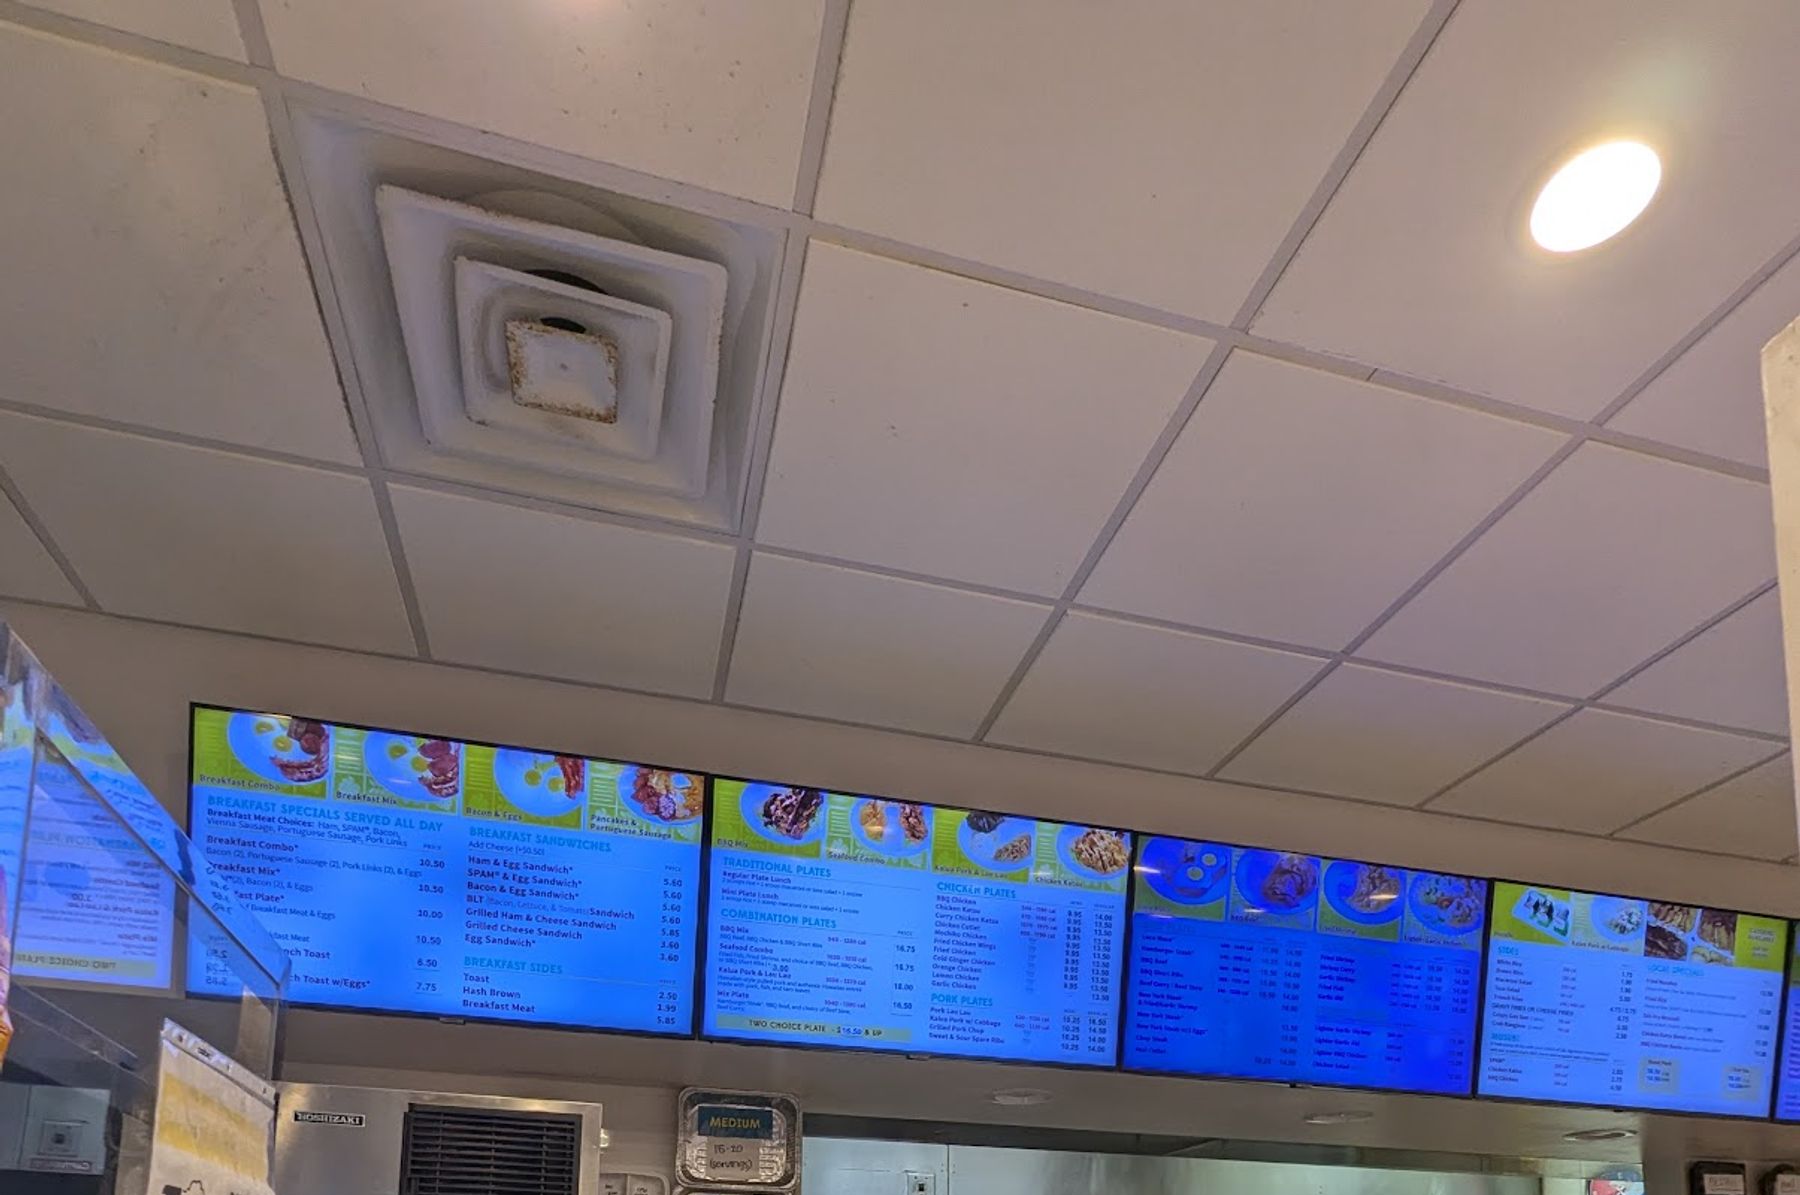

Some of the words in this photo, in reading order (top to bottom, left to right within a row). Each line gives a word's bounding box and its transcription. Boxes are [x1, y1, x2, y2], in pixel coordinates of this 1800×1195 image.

[200, 774, 245, 787] Breakfast
[248, 781, 280, 791] Combo
[336, 791, 380, 802] Breakfast
[382, 797, 397, 805] Mix
[207, 796, 276, 813] BREAKFAST
[281, 804, 340, 820] SPECIALS
[344, 811, 390, 826] SERVED
[394, 818, 415, 830] ALL
[420, 822, 443, 832] DAY
[466, 807, 492, 816] Bacon
[502, 811, 522, 821] Eggs
[590, 814, 629, 826] Pancakes
[207, 808, 251, 820] Breakfast
[254, 814, 275, 823] Meat
[277, 817, 315, 828] Choices:
[373, 828, 400, 838] Bacon,
[207, 818, 236, 828] Vienna
[240, 821, 275, 833] Sausage,
[328, 831, 363, 844] Sausage,
[365, 835, 384, 844] Pork
[386, 838, 407, 847] Links
[469, 826, 532, 844] BREAKFAST
[535, 834, 612, 852] SANDWICHES
[590, 824, 636, 837] Portuguese
[638, 830, 672, 841] Sausage
[206, 835, 256, 848] Breakfast
[828, 850, 858, 862] Seafood
[419, 859, 445, 869] 10.50
[468, 855, 492, 866] Ham
[503, 859, 520, 871] Egg
[723, 856, 793, 874] TRADITIONAL
[796, 865, 832, 878] PLATES
[512, 873, 530, 886] Egg
[664, 878, 682, 888] 5.60
[723, 870, 750, 882] Regular
[752, 873, 769, 882] Plate
[770, 874, 792, 884] Lunch
[418, 884, 444, 894] 10.50
[467, 881, 497, 892] Bacon
[509, 886, 527, 898] Egg
[663, 890, 682, 900] 5.60
[738, 889, 756, 898] Plate
[758, 891, 779, 900] Lunch
[937, 882, 982, 896] CHICKEN
[984, 886, 1016, 899] PLATES
[466, 894, 484, 904] BLT
[590, 907, 635, 920] Sandwich
[662, 903, 682, 913] 5.60
[466, 907, 499, 919] Grilled
[502, 912, 523, 922] Ham
[535, 914, 569, 926] Cheese
[572, 918, 616, 931] Sandwich
[661, 916, 681, 926] 5.60
[720, 908, 798, 925] COMBINATION
[802, 916, 836, 928] PLATES
[954, 914, 980, 924] Chicken
[465, 920, 498, 932] Grilled
[500, 924, 534, 936] Cheese
[538, 927, 582, 940] Sandwich
[660, 928, 680, 938] 5.85
[416, 935, 442, 946] 10.50
[465, 933, 484, 945] Egg
[304, 949, 331, 959] Toast
[720, 942, 748, 952] Seafood
[750, 945, 774, 954] Combo
[464, 956, 526, 972] BREAKFAST
[530, 963, 563, 975] SIDES
[304, 975, 329, 985] Toast
[464, 973, 490, 984] Toast
[416, 982, 437, 992] 7.75
[463, 986, 488, 997] Hash
[490, 989, 521, 1000] Brown
[658, 992, 678, 1001] 2.50
[732, 991, 749, 1000] Plate
[931, 993, 958, 1004] PORK
[961, 996, 993, 1007] PLATES
[462, 999, 510, 1012] Breakfast
[512, 1003, 536, 1014] Meat
[657, 1004, 677, 1014] 1.99
[656, 1016, 676, 1026] 5.85
[750, 1019, 768, 1028] TWO
[769, 1020, 801, 1032] CHOICE
[804, 1022, 826, 1033] PLATE
[872, 1028, 882, 1036] UP
[297, 1111, 362, 1126] HOSHIZAKI
[710, 1116, 760, 1128] MEDIUM
[709, 1158, 753, 1172] (servings)
